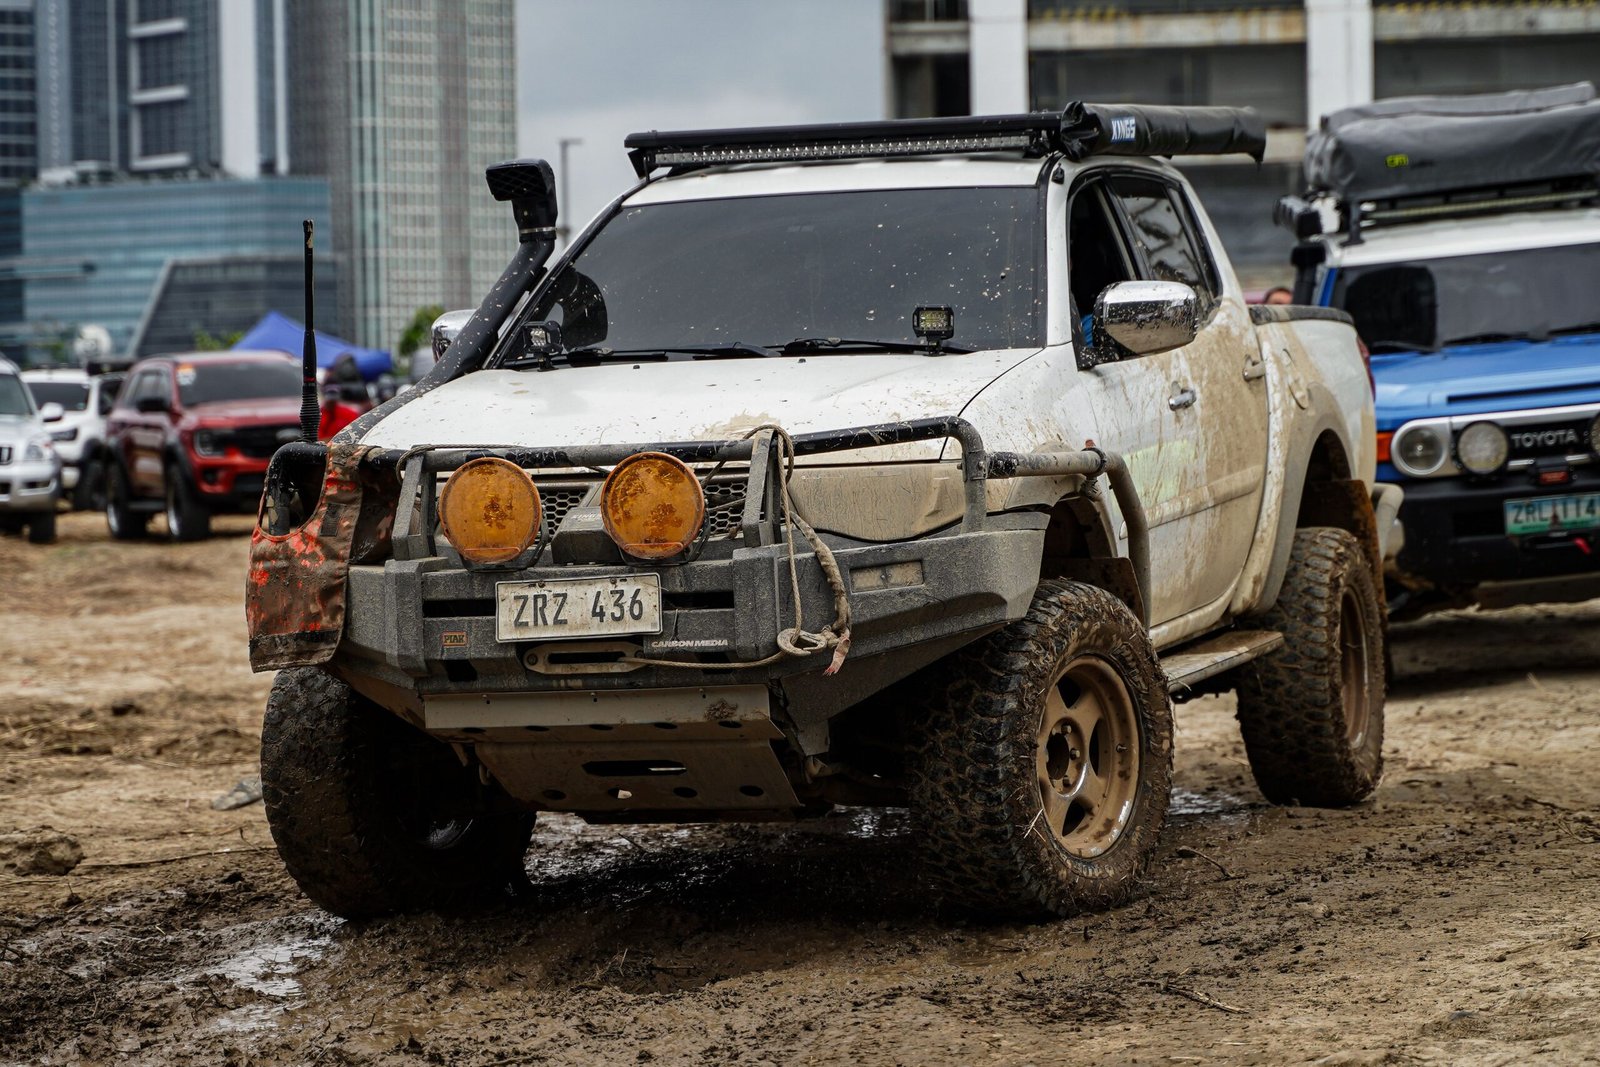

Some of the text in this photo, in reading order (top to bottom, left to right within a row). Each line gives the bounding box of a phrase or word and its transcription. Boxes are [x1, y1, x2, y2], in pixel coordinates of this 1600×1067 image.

[1510, 429, 1577, 448] TOYOTA
[1512, 501, 1549, 524] ZRL
[513, 588, 644, 628] ZRZ 436
[694, 638, 729, 647] MEDIA
